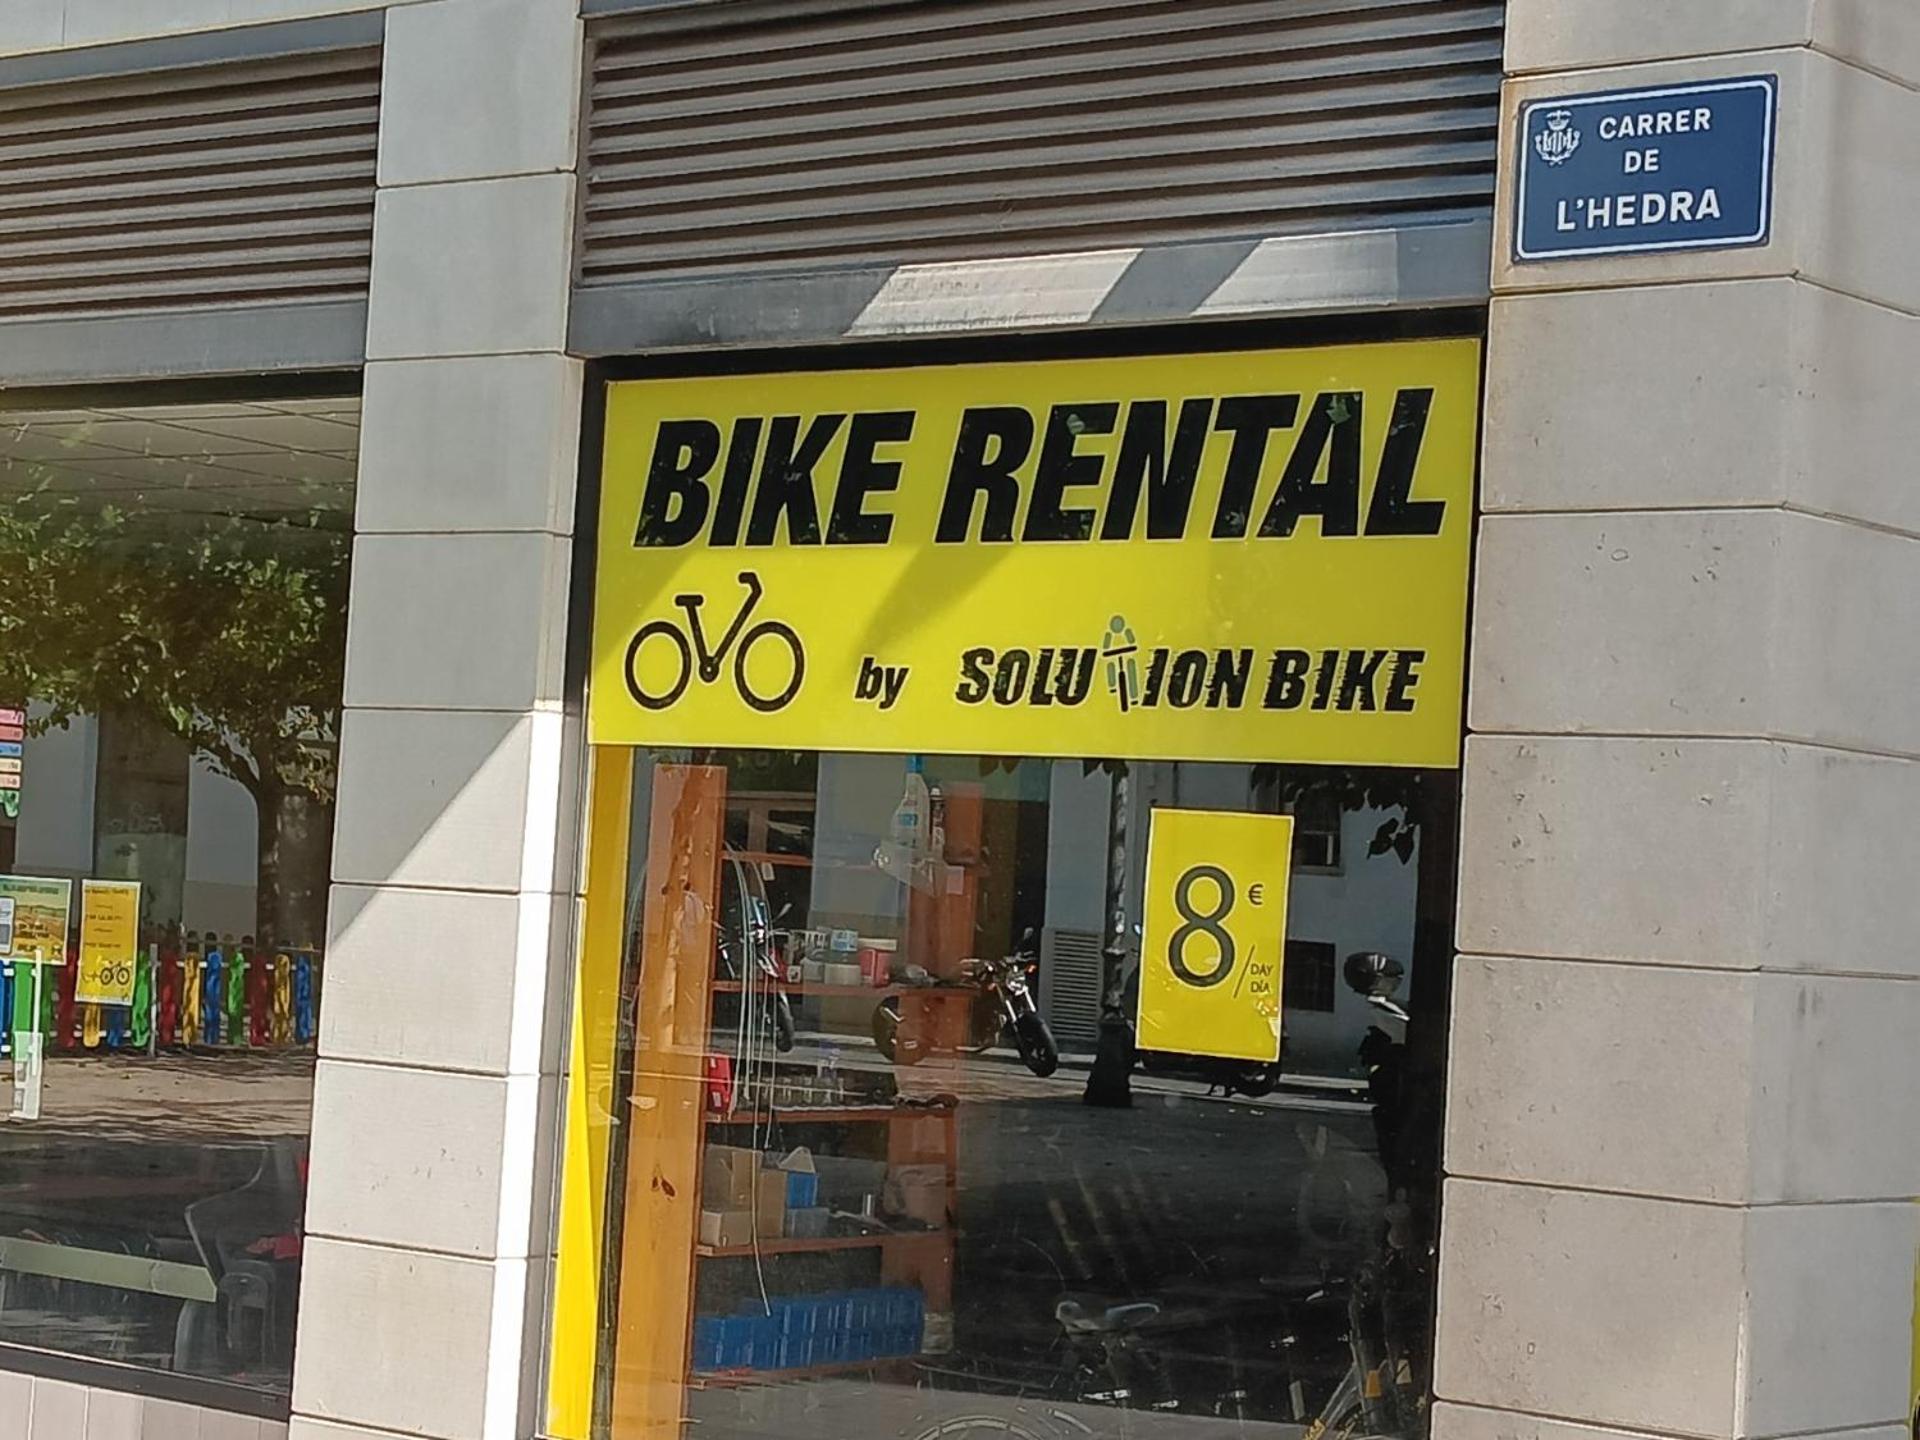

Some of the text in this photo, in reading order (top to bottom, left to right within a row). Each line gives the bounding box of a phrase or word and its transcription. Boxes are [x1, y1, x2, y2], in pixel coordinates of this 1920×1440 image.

[1599, 108, 1711, 139] CARRER
[1624, 149, 1659, 173] DE
[1557, 188, 1721, 231] L'HEDRA
[633, 388, 1446, 547] BIKE RENTAL
[854, 657, 909, 708] by
[1260, 649, 1426, 712] BIKE
